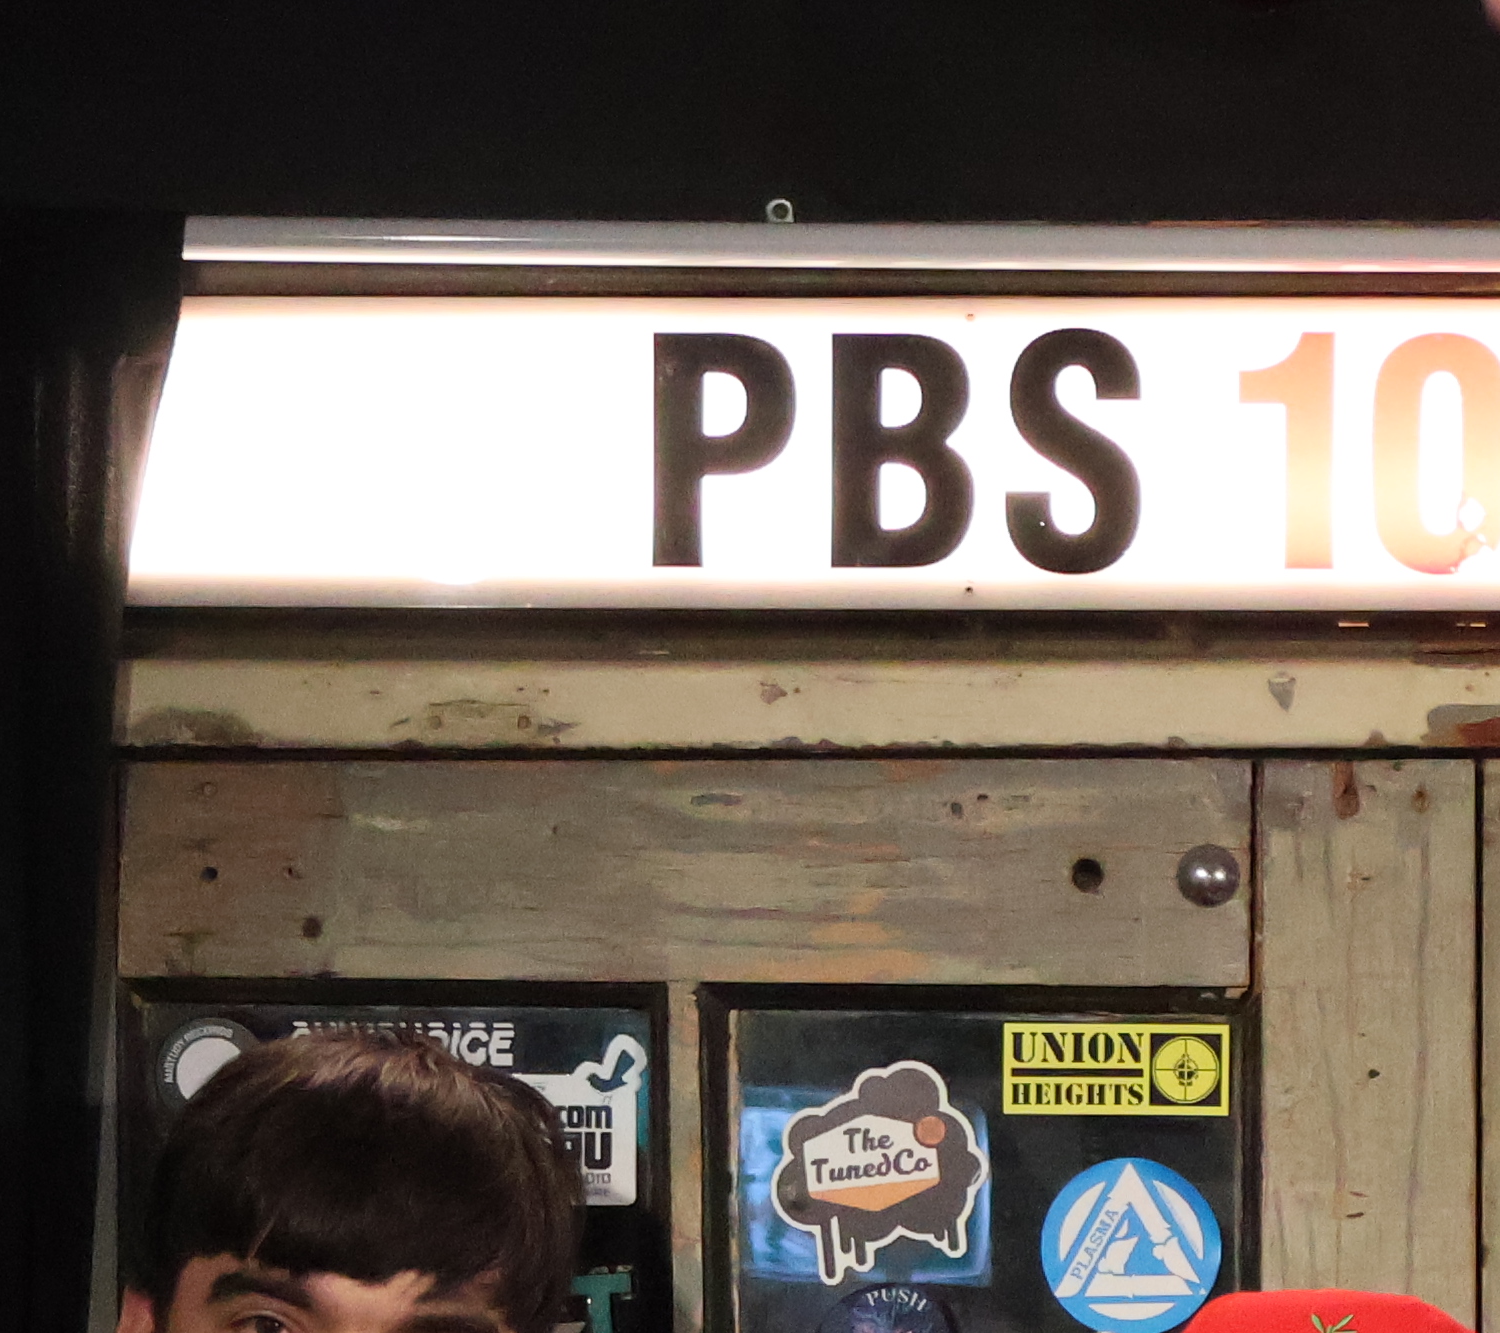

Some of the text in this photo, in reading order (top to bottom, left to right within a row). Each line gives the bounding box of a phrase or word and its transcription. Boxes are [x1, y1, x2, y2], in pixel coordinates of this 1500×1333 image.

[653, 328, 1142, 576] PBS
[1011, 1032, 1144, 1063] UNION
[1011, 1083, 1144, 1105] HEIGHTS
[843, 1128, 894, 1154] The
[810, 1148, 933, 1184] TunedCo
[1070, 1209, 1119, 1280] PLASMA
[865, 1288, 928, 1311] PUSH
